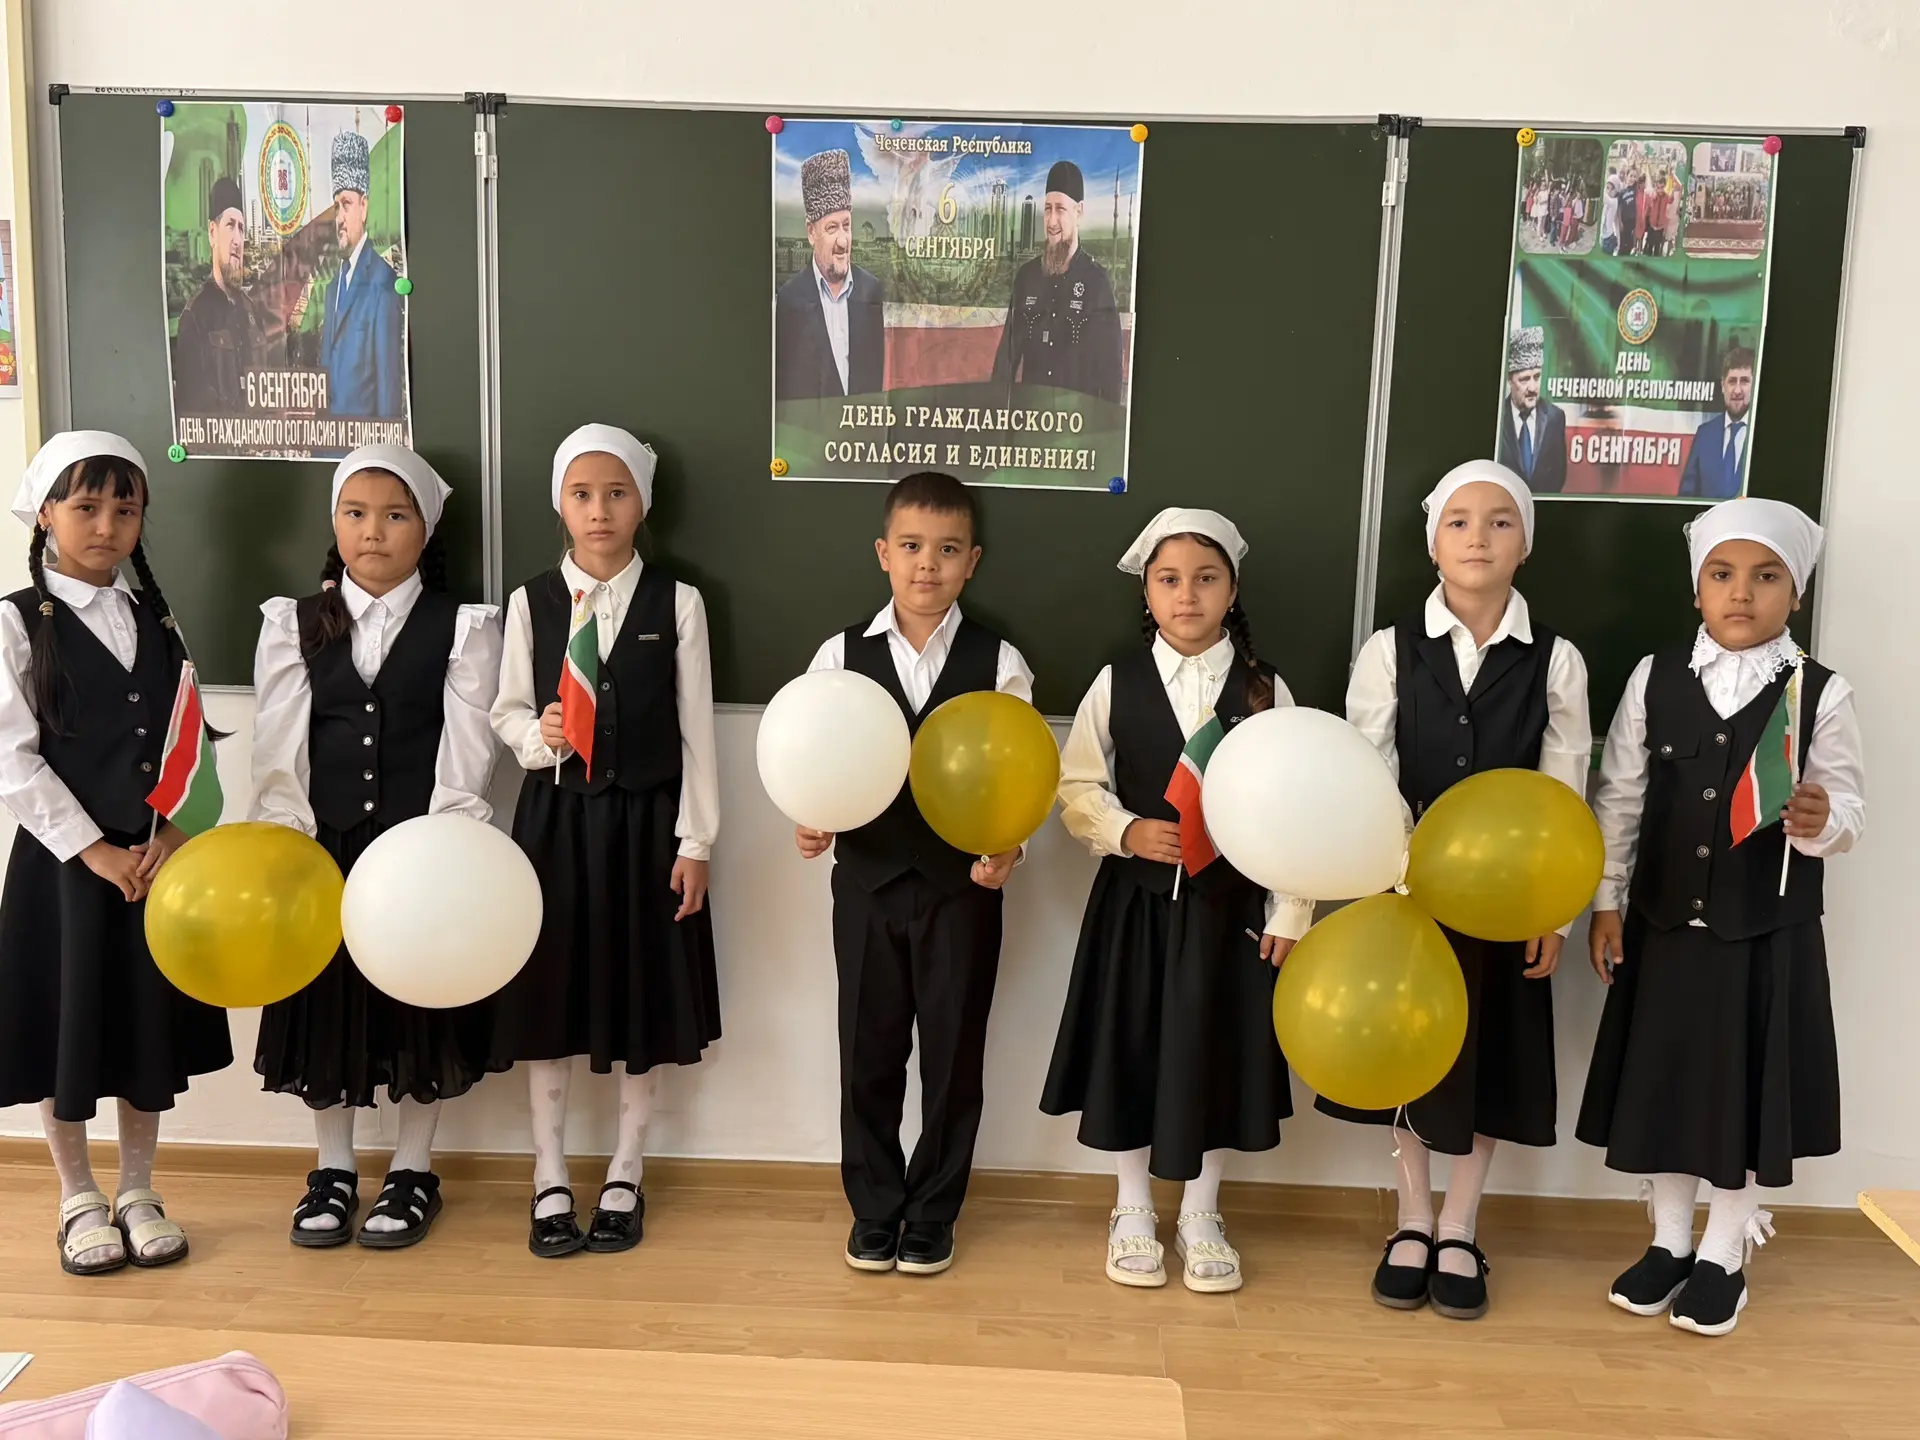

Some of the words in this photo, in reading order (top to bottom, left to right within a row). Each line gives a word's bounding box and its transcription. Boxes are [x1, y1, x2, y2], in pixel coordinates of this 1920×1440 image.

[875, 134, 948, 152] Чеченская
[952, 135, 1032, 157] Республика
[938, 182, 957, 224] 6
[905, 235, 996, 260] СЕНТЯБРЯ
[1615, 351, 1651, 374] ДЕНЬ
[247, 371, 256, 408] 6
[259, 371, 328, 409] СЕНТЯБРЯ
[1547, 374, 1624, 399] ЧЕЧЕНСКОЙ
[1626, 379, 1715, 401] РЕСПУБЛИКИ!
[839, 404, 897, 429] ДЕНЬ
[905, 406, 1084, 433] ГРАЖДАНСКОГО
[179, 417, 205, 447] ДЕНЬ
[206, 418, 283, 448] ГРАЖДАНСКОГО
[284, 419, 336, 447] СОГЛАСИЯ
[338, 421, 346, 447] И
[347, 421, 403, 450] ЕДИНЕНИЯ!
[824, 441, 937, 464] СОГЛАСИЯ
[946, 444, 960, 465] И
[969, 445, 1097, 471] ЕДИНЕНИЯ!
[1570, 434, 1583, 464] 6
[1586, 435, 1682, 465] СЕНТЯБРЯ
